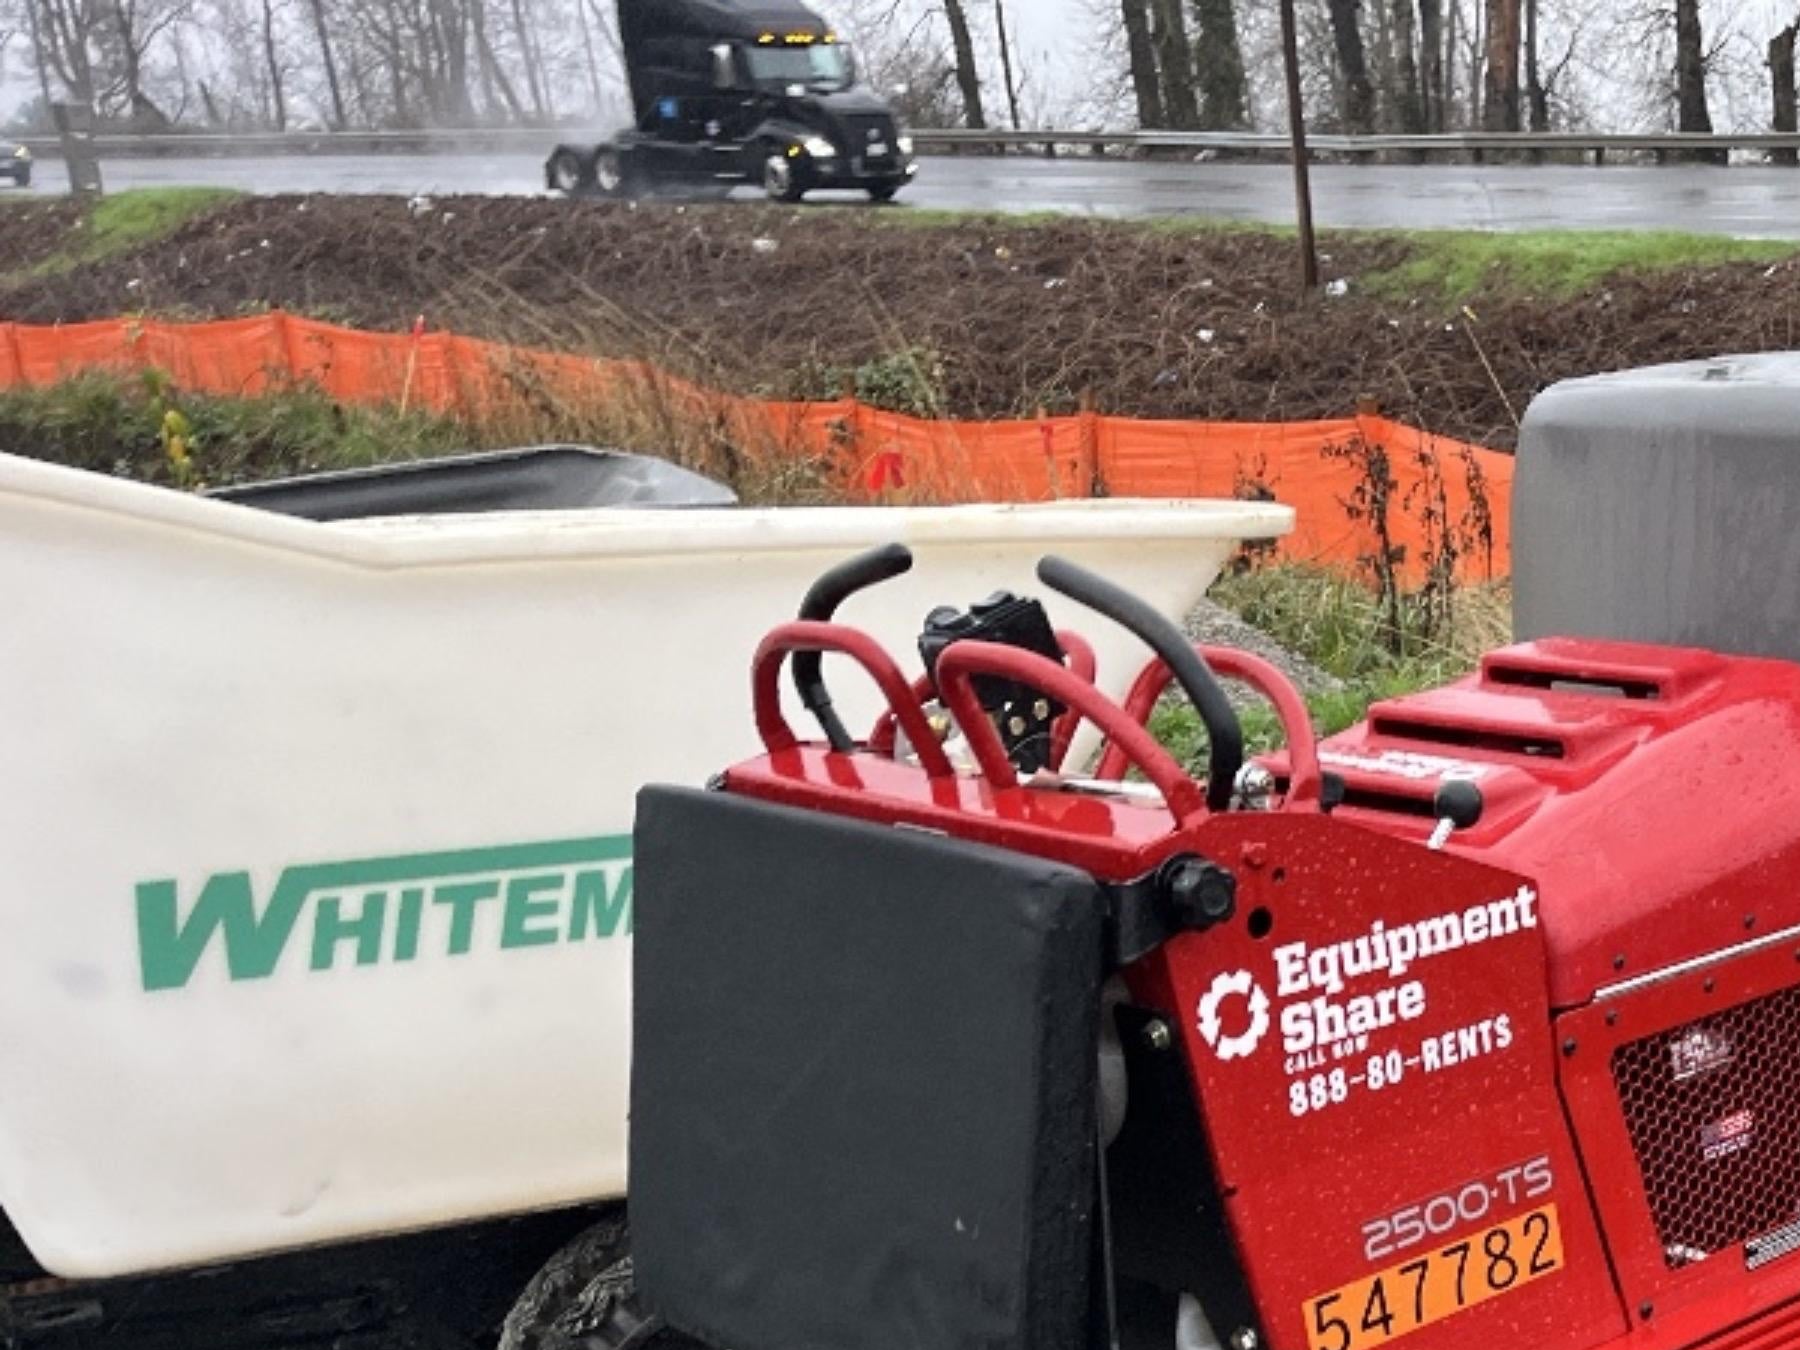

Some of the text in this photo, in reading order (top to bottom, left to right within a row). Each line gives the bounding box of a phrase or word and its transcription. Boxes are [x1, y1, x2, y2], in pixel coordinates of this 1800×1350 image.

[1272, 884, 1538, 997] Equipment
[1280, 979, 1426, 1055] Share
[1284, 1034, 1369, 1075] CALL NOW
[1288, 1014, 1514, 1117] 888-80-RENTS
